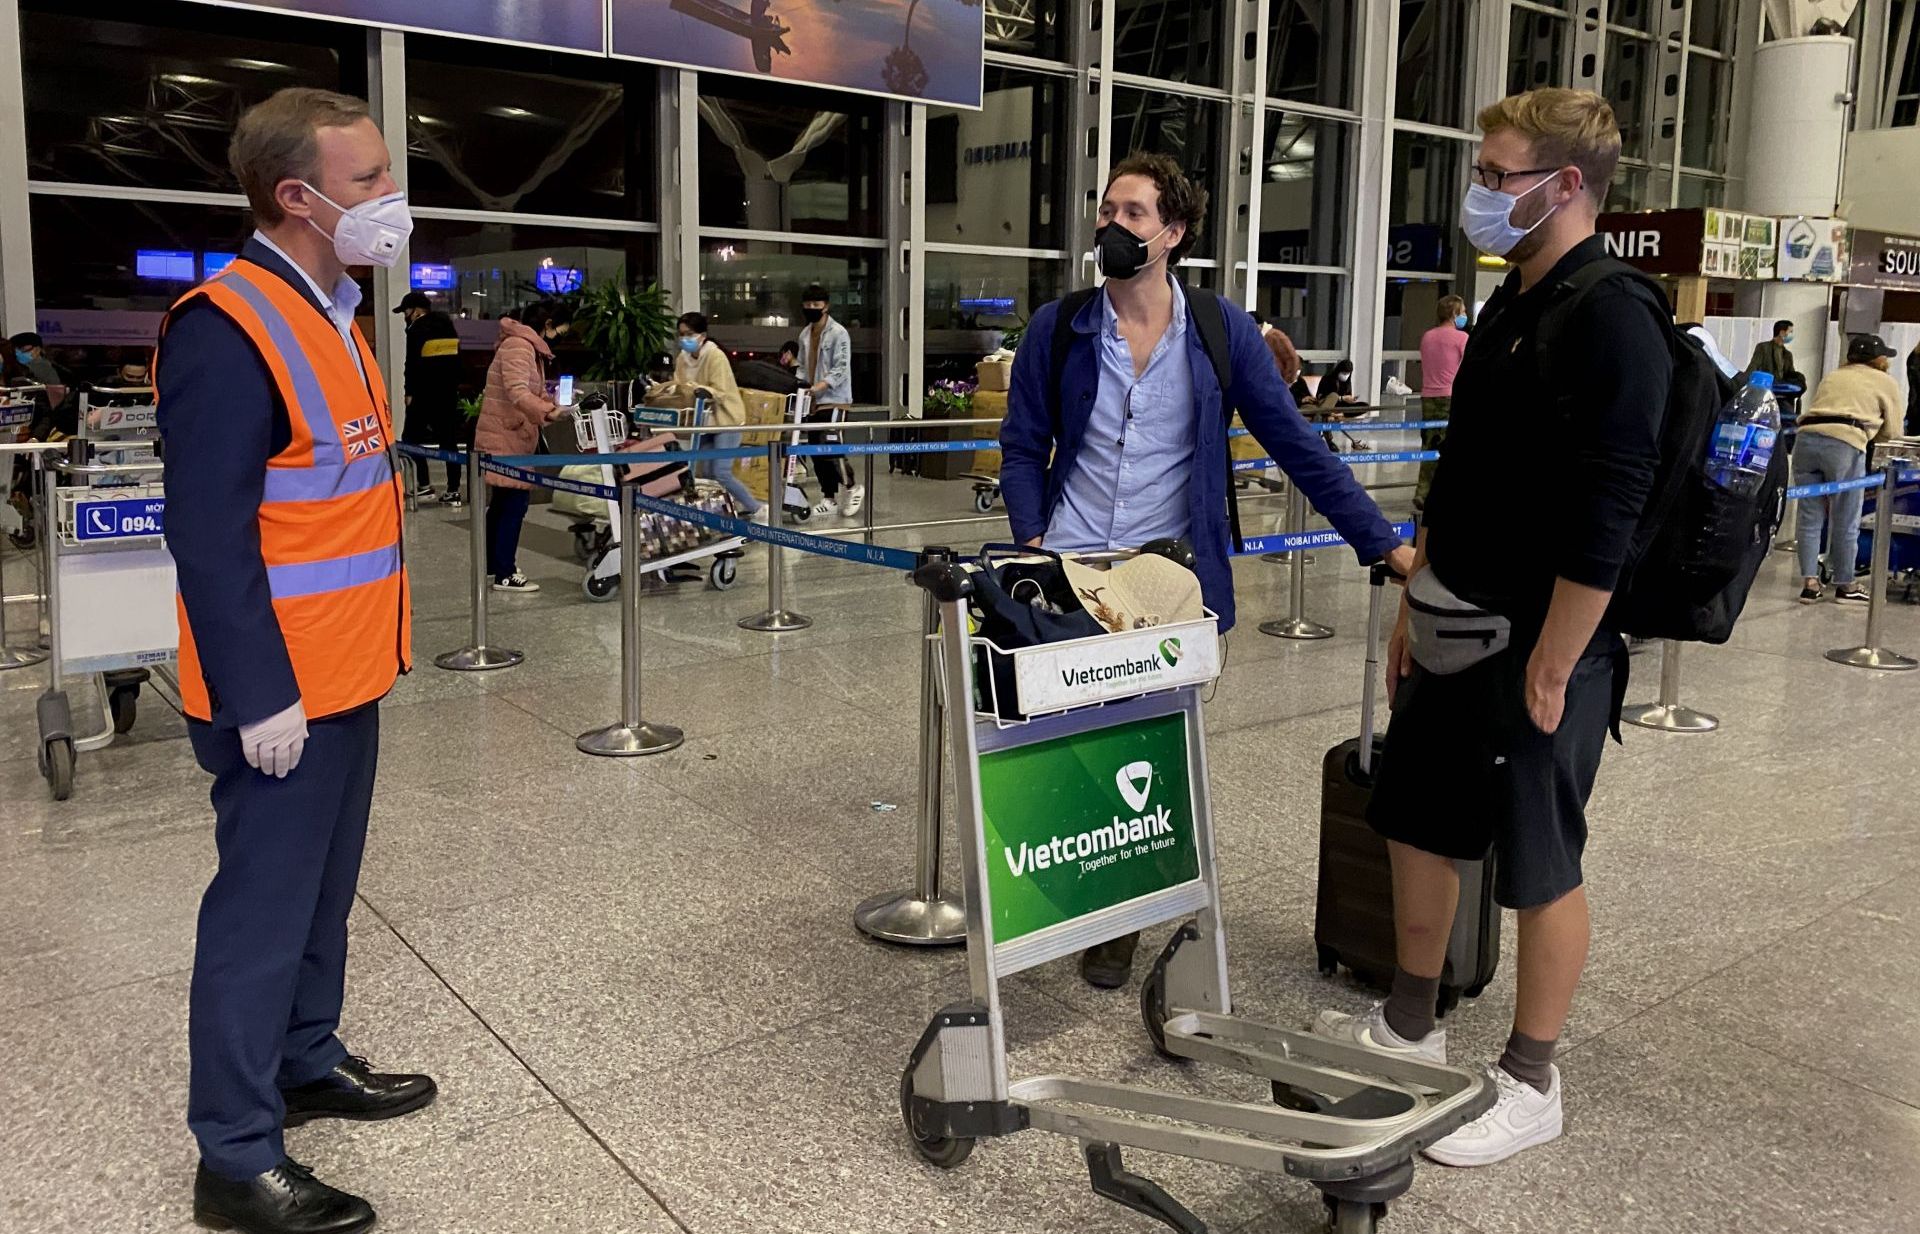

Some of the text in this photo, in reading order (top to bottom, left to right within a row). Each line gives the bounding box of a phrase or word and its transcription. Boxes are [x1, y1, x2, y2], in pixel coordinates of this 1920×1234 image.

[1885, 249, 1920, 275] SOU
[126, 412, 155, 421] DOR
[768, 530, 817, 550] INTERNATIONAL
[818, 539, 848, 555] AIRPORT
[1312, 532, 1345, 544] INTERNA
[1062, 653, 1161, 687] Vietcombank
[1004, 804, 1173, 876] Vietcombank
[1079, 836, 1176, 874] Together for the future
